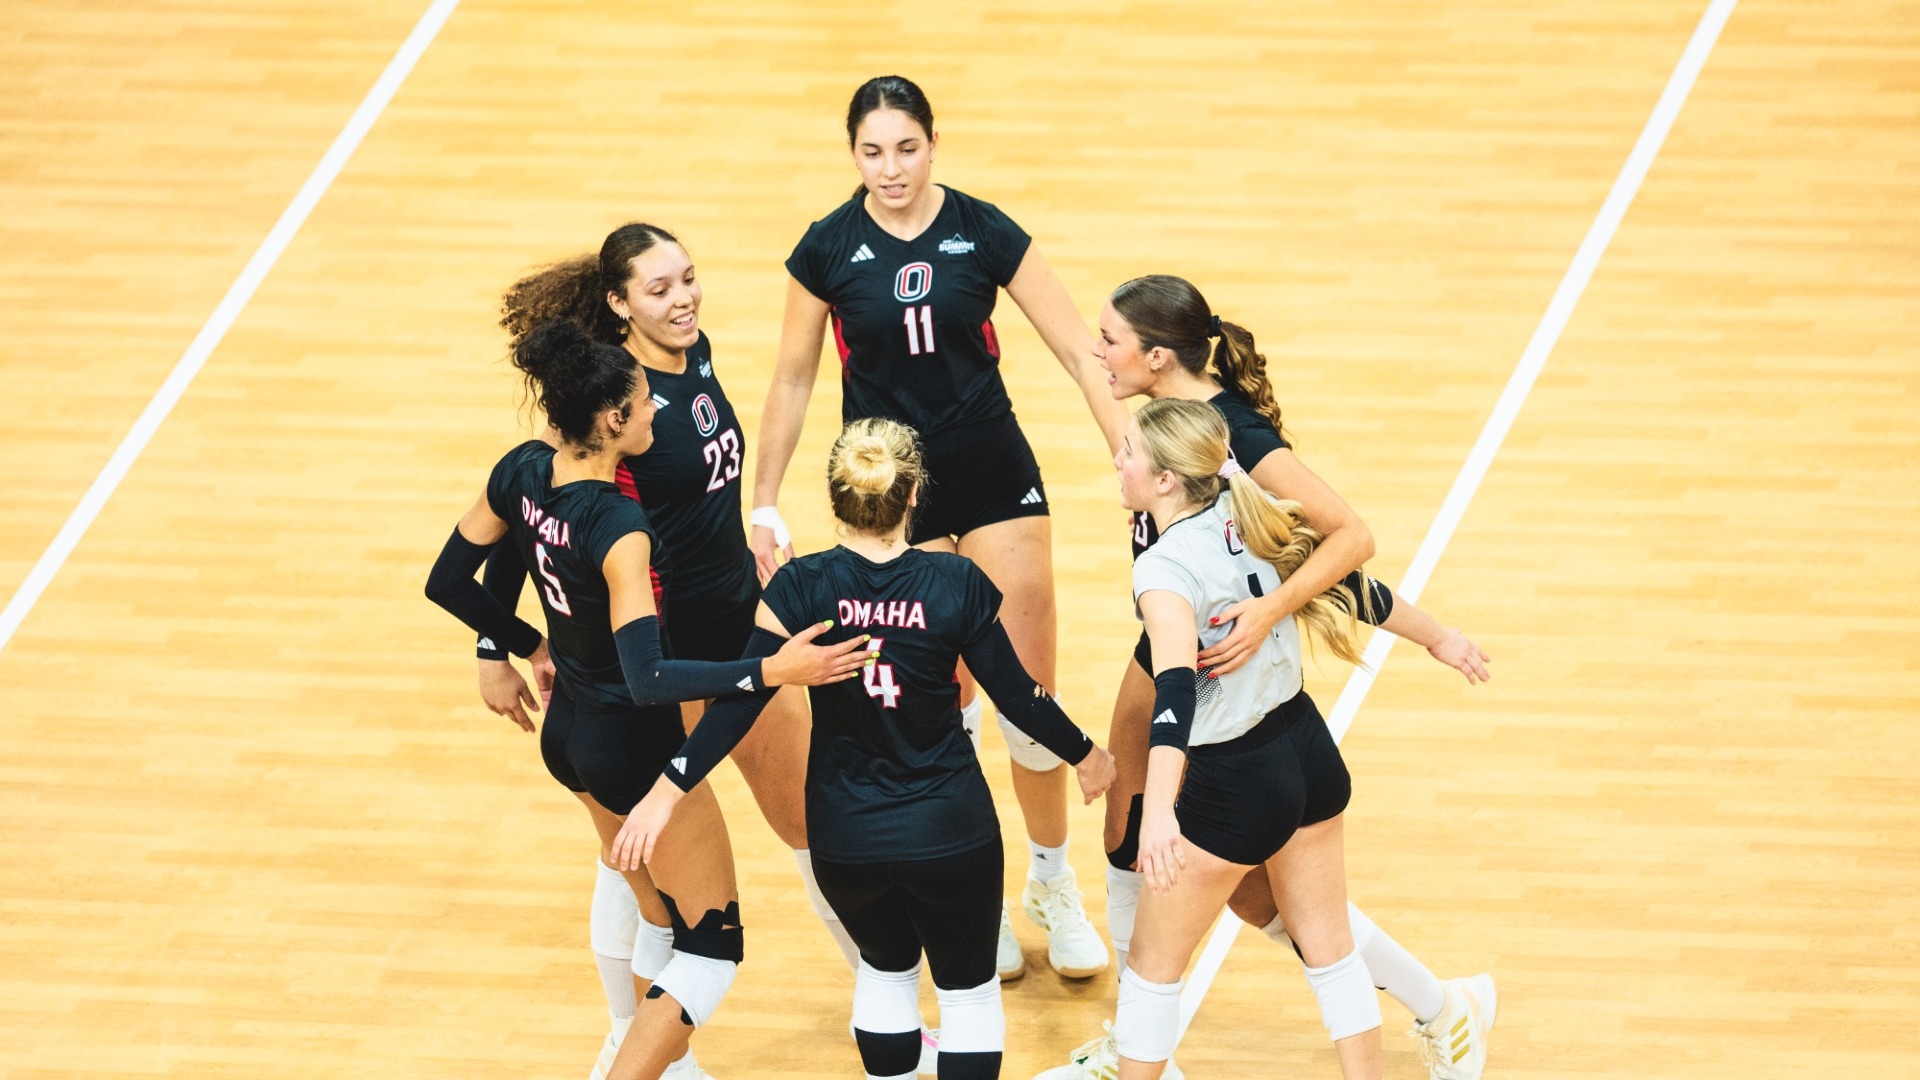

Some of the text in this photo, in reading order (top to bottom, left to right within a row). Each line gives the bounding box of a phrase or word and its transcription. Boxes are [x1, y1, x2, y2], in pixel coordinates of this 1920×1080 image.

[894, 261, 933, 303] O
[903, 304, 935, 356] 11
[691, 393, 719, 437] O
[703, 428, 741, 493] 23
[535, 541, 572, 617] 5
[838, 599, 927, 630] OMAHA
[862, 637, 902, 709] 4
